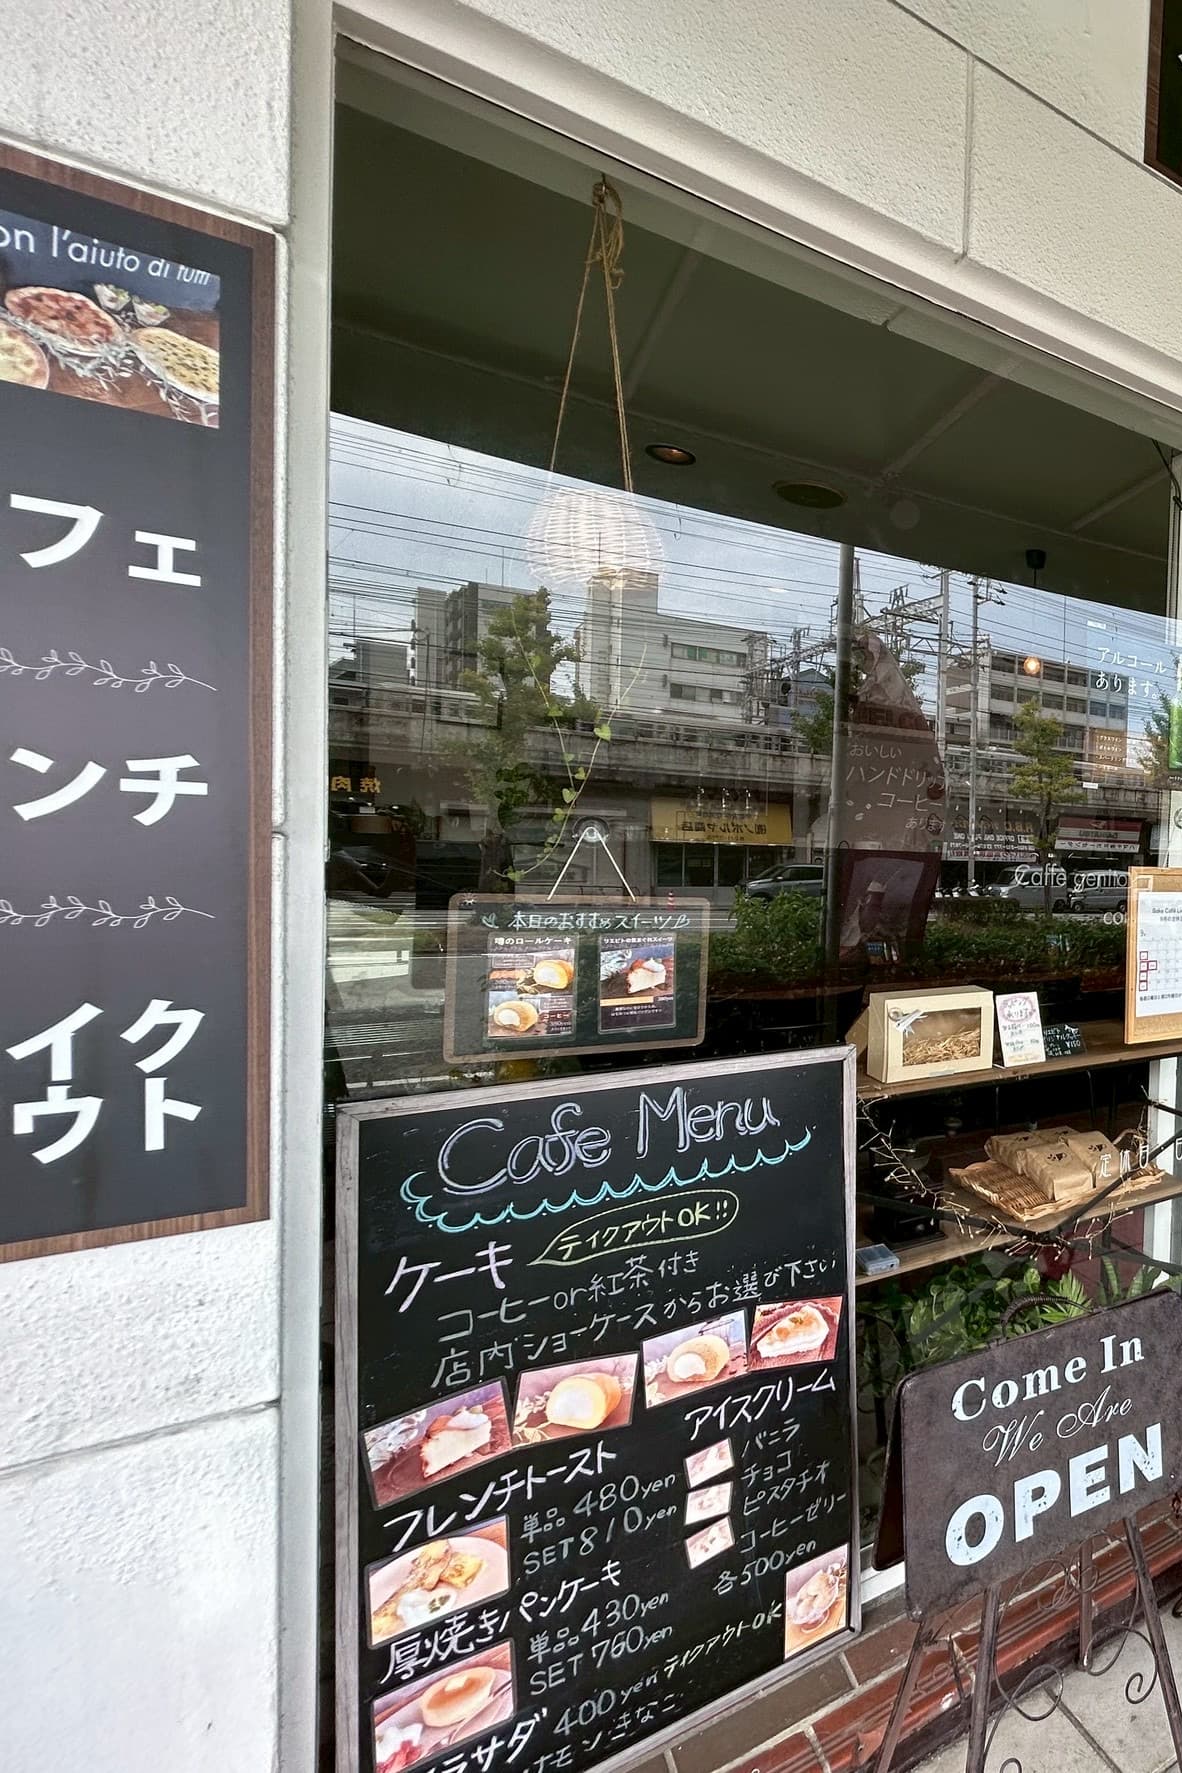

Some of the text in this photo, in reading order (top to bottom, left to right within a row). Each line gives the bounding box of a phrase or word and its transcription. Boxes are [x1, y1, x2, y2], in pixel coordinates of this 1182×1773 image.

[10, 493, 201, 587] フェ
[1098, 647, 1167, 674] アルコール
[10, 747, 208, 826] ンチ
[850, 743, 902, 759] おいしい
[877, 793, 943, 812] コーヒー
[508, 910, 671, 930] 本日のおすすめスイーツ
[6, 999, 205, 1074] イク
[13, 1077, 202, 1164] ウト
[437, 1086, 781, 1196] Cafe Menu
[384, 1240, 513, 1313] ケーキ
[684, 1368, 836, 1440] アイスクリーム
[951, 1335, 1145, 1422] Come In
[741, 1418, 800, 1458] バニラ
[982, 1384, 1132, 1467] We Are
[384, 1441, 618, 1553] フレンチトースト
[740, 1450, 792, 1487] チョコ
[743, 1460, 831, 1516] ピスタチオ
[945, 1422, 1163, 1567] OPEN
[520, 1508, 565, 1543] 単品
[740, 1493, 847, 1553] コーヒーゼリー
[379, 1559, 622, 1684] 厚焼きパンケーキ
[527, 1626, 579, 1664] 単品
[426, 1707, 548, 1773] ラサダ
